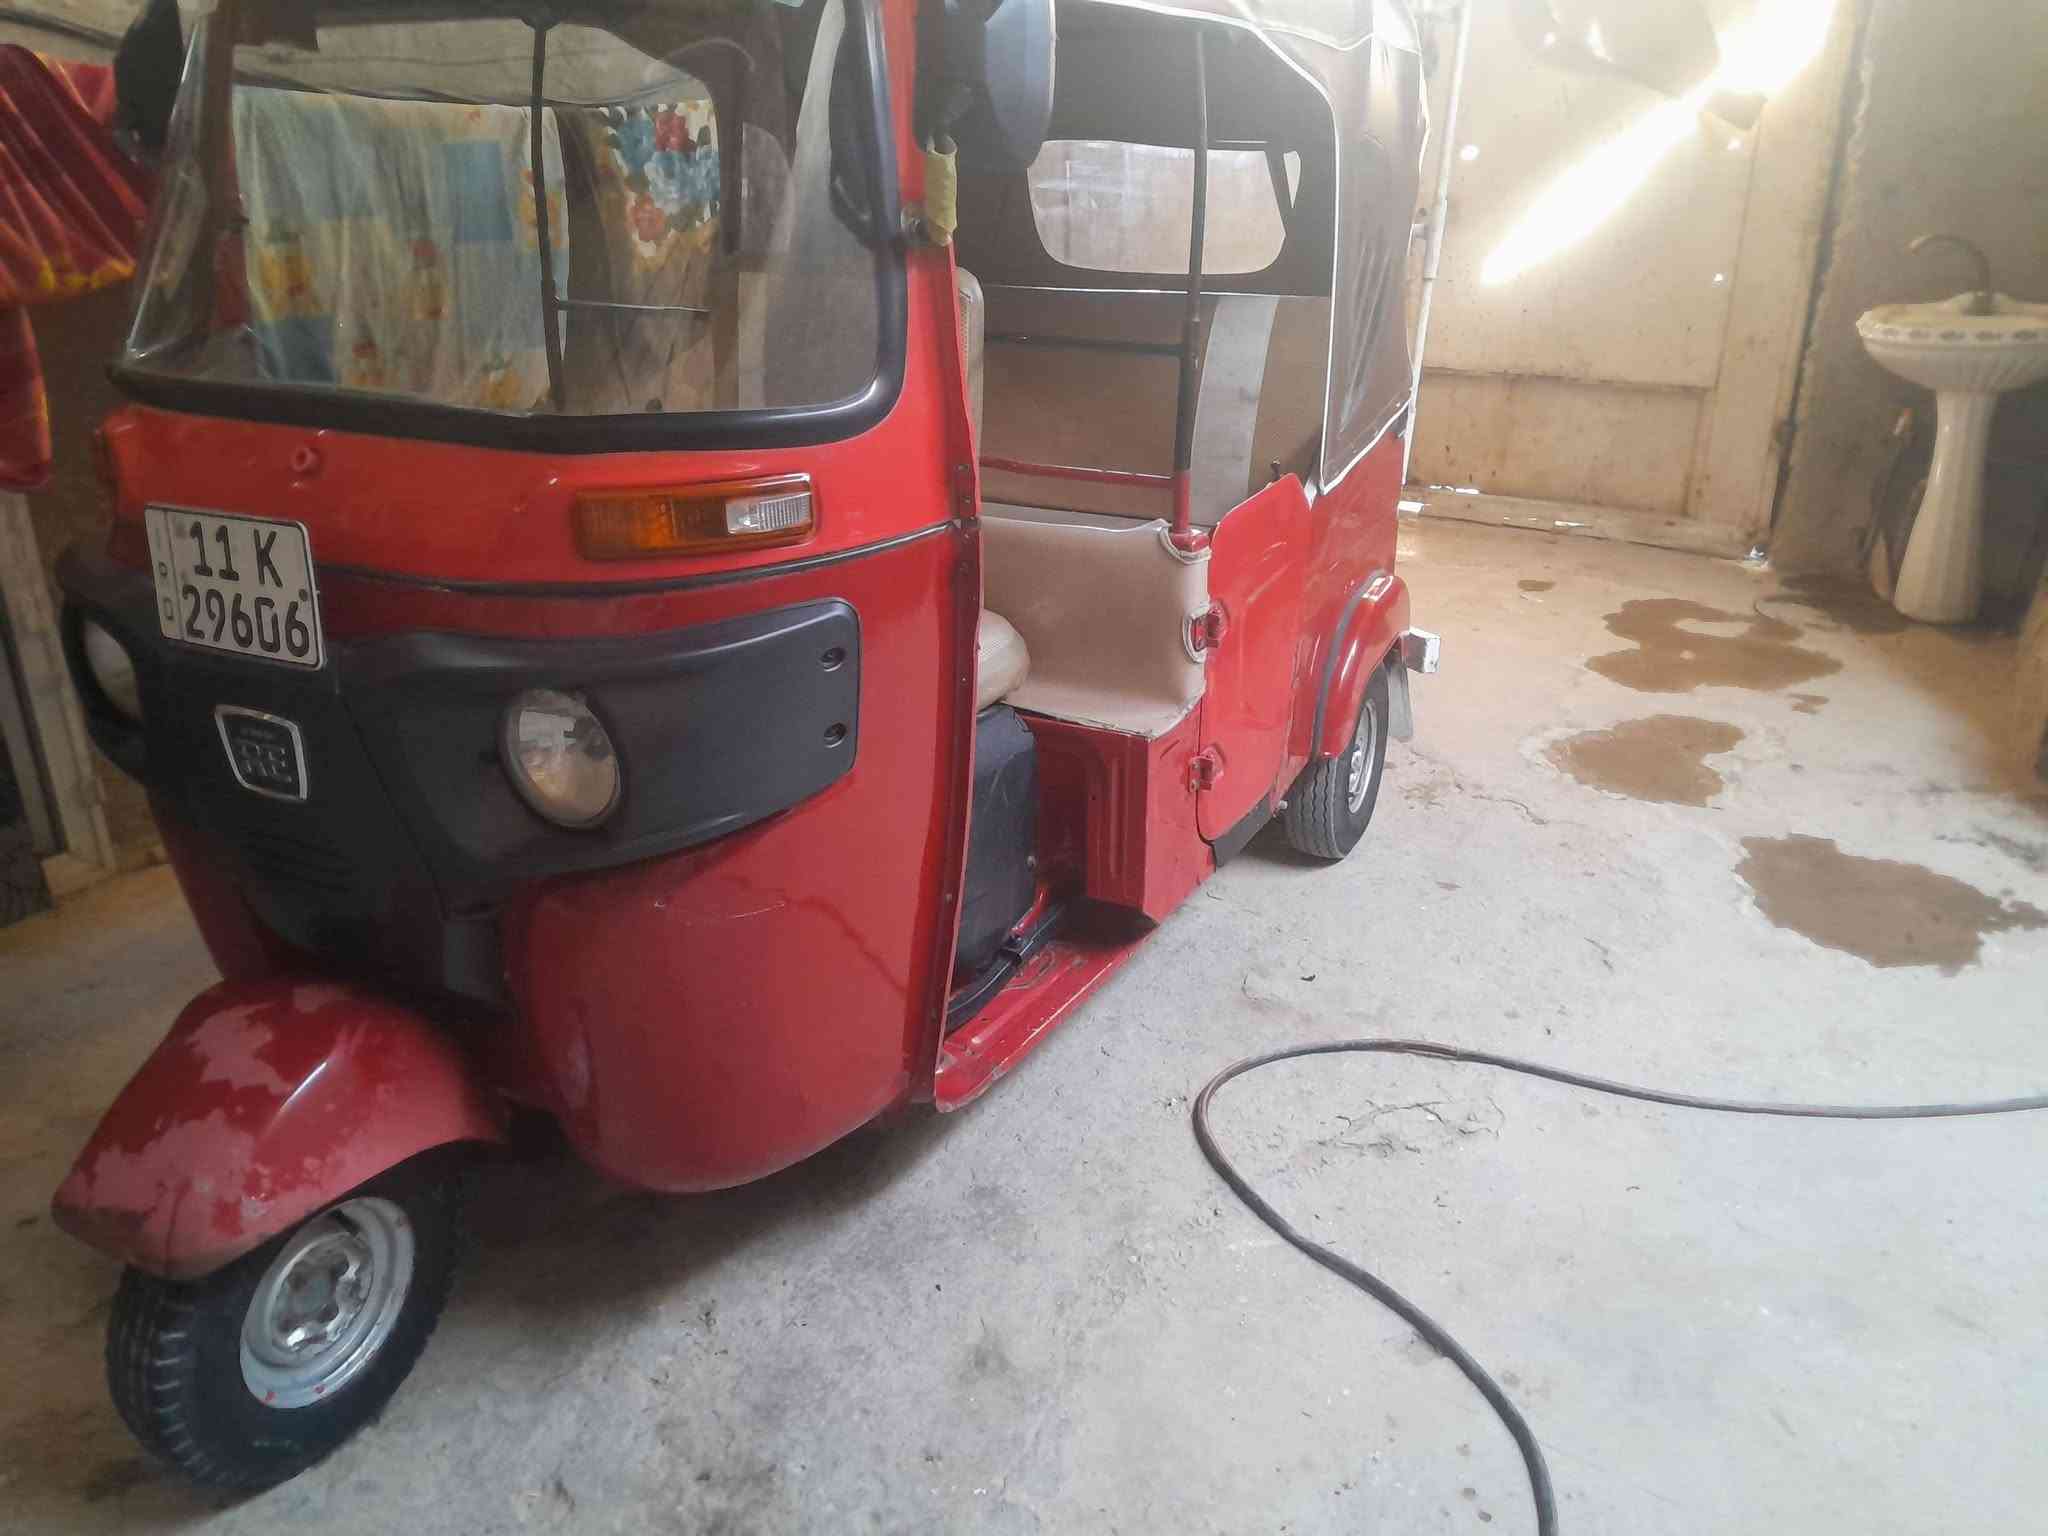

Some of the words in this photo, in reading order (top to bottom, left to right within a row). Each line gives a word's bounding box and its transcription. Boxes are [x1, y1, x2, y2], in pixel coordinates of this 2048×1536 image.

[190, 521, 239, 581] 11
[253, 529, 282, 588] K
[182, 585, 309, 657] 29606
